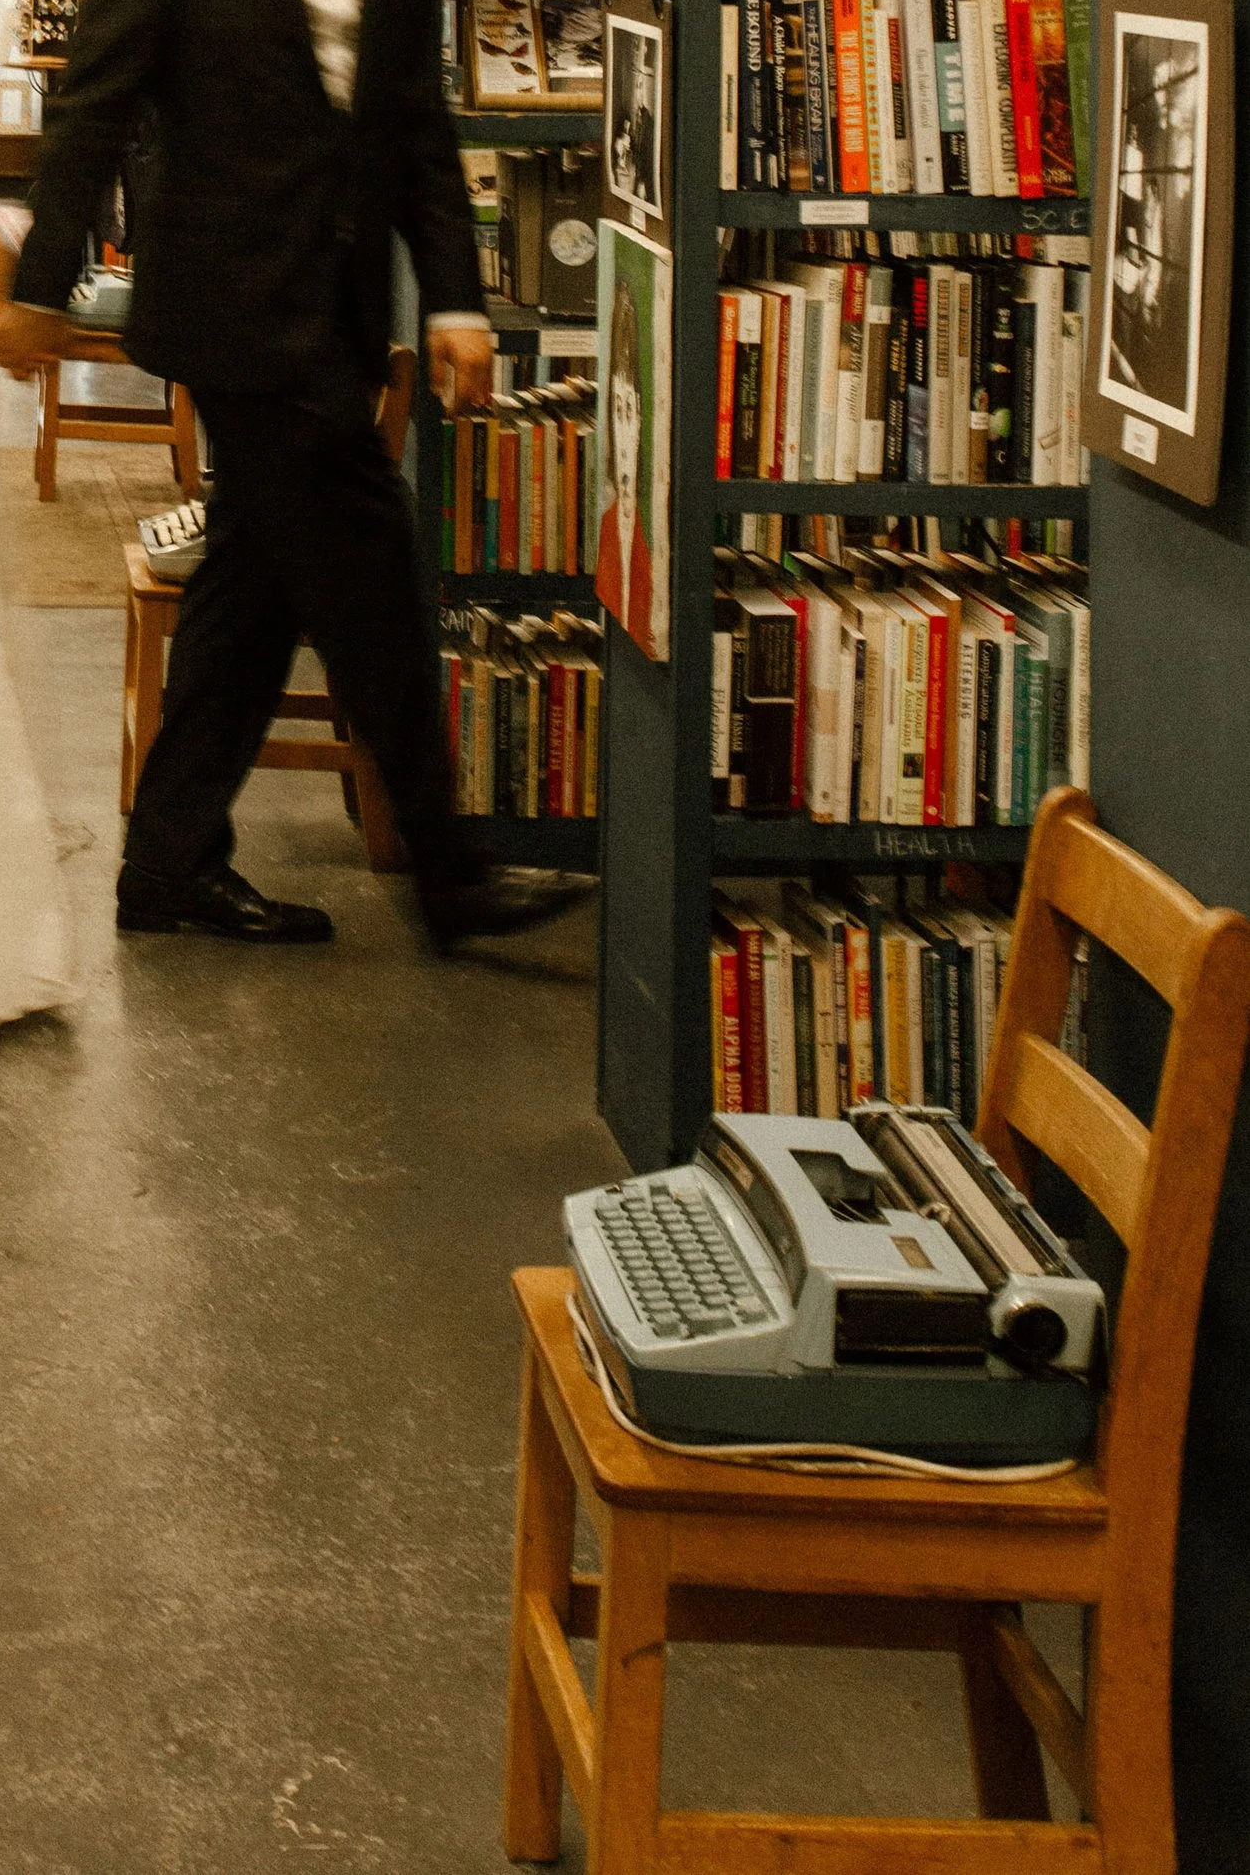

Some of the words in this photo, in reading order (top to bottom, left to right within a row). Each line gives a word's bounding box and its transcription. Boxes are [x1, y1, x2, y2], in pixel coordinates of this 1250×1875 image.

[747, 11, 761, 71] BOUND
[774, 27, 785, 54] Child
[808, 23, 821, 84] HEALING
[888, 20, 900, 79] inevitable
[994, 24, 1010, 90] EXPLORING
[775, 65, 785, 91] Born
[944, 52, 964, 122] TIME
[811, 87, 823, 131] BRAIN
[893, 85, 905, 137] illusions
[999, 98, 1015, 173] COMPLEXITY
[845, 128, 864, 152] MIND
[915, 622, 927, 683] Caregivers
[961, 645, 973, 719] ATTENDING
[980, 641, 994, 720] Complications
[904, 688, 914, 748] Assistants
[917, 688, 927, 739] Personal
[1030, 672, 1043, 718] HEAL
[1052, 678, 1067, 764] YOUNGER
[723, 1016, 740, 1066] ALPHA
